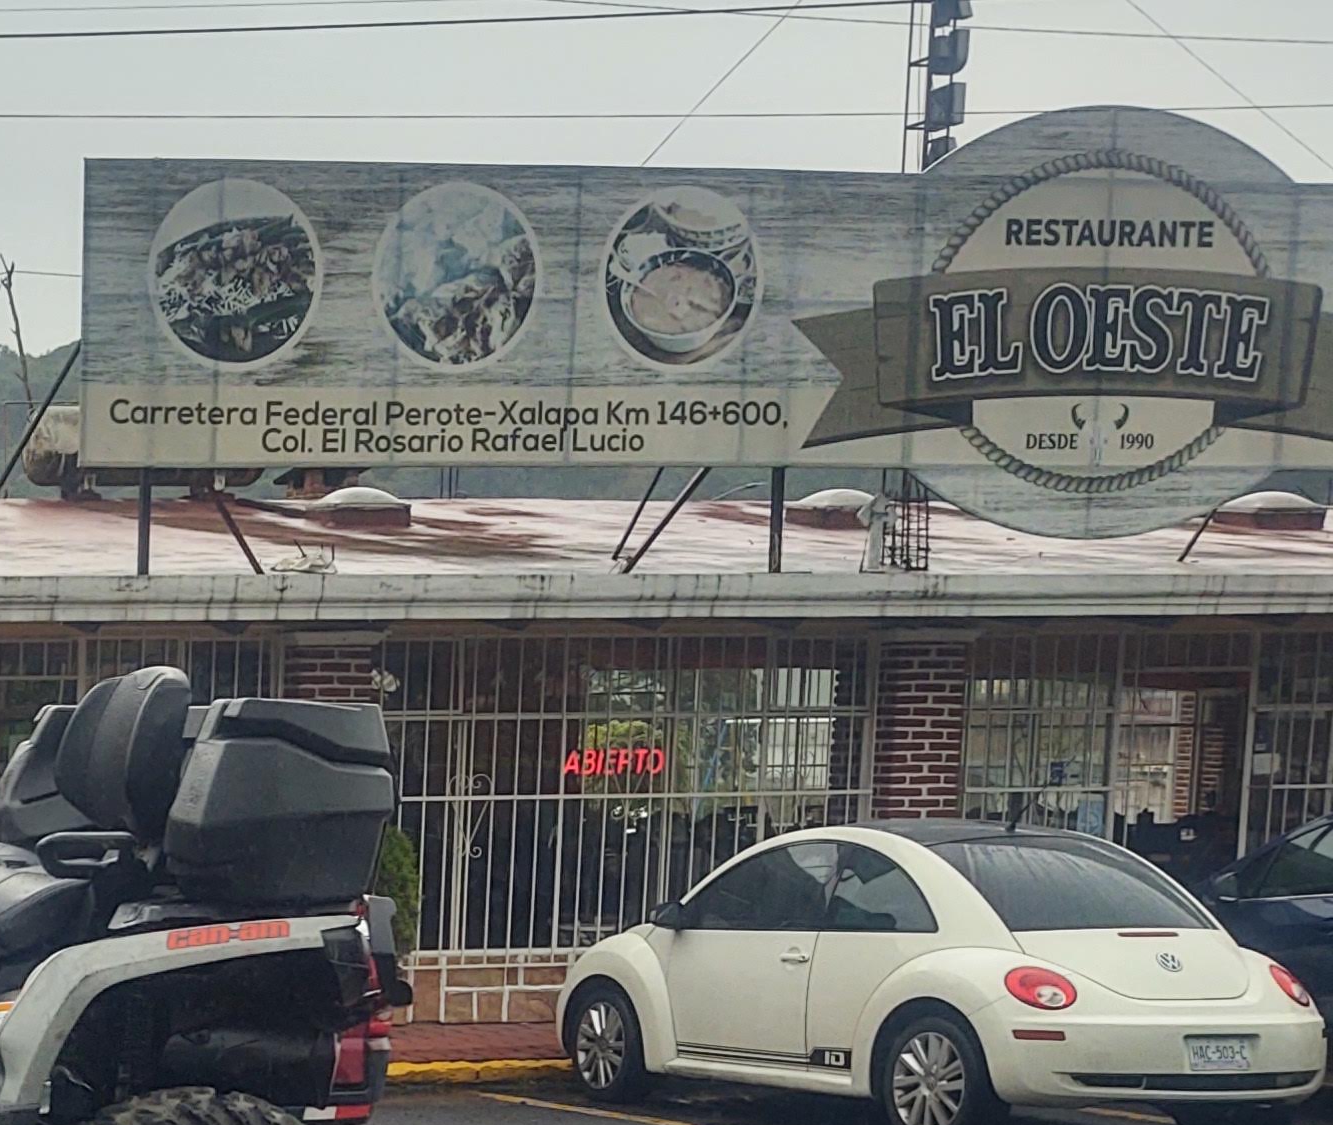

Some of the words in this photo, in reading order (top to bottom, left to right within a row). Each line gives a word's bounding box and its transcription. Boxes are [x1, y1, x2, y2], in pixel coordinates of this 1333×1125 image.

[1005, 218, 1215, 247] RESTAURANTE
[930, 288, 1023, 381] EL
[1030, 282, 1269, 382] OESTE
[110, 399, 257, 425] Carretera
[265, 401, 377, 426] Federal
[385, 400, 598, 431] Perote-Xalapa
[607, 401, 650, 425] Km
[657, 400, 787, 429] 146+600,
[261, 427, 313, 452] Col.
[321, 428, 346, 452] El
[354, 427, 463, 452] Rosario
[471, 427, 565, 452] Rafael
[572, 428, 644, 452] Lucio
[1026, 433, 1078, 450] DESDE
[1120, 433, 1154, 450] 1990
